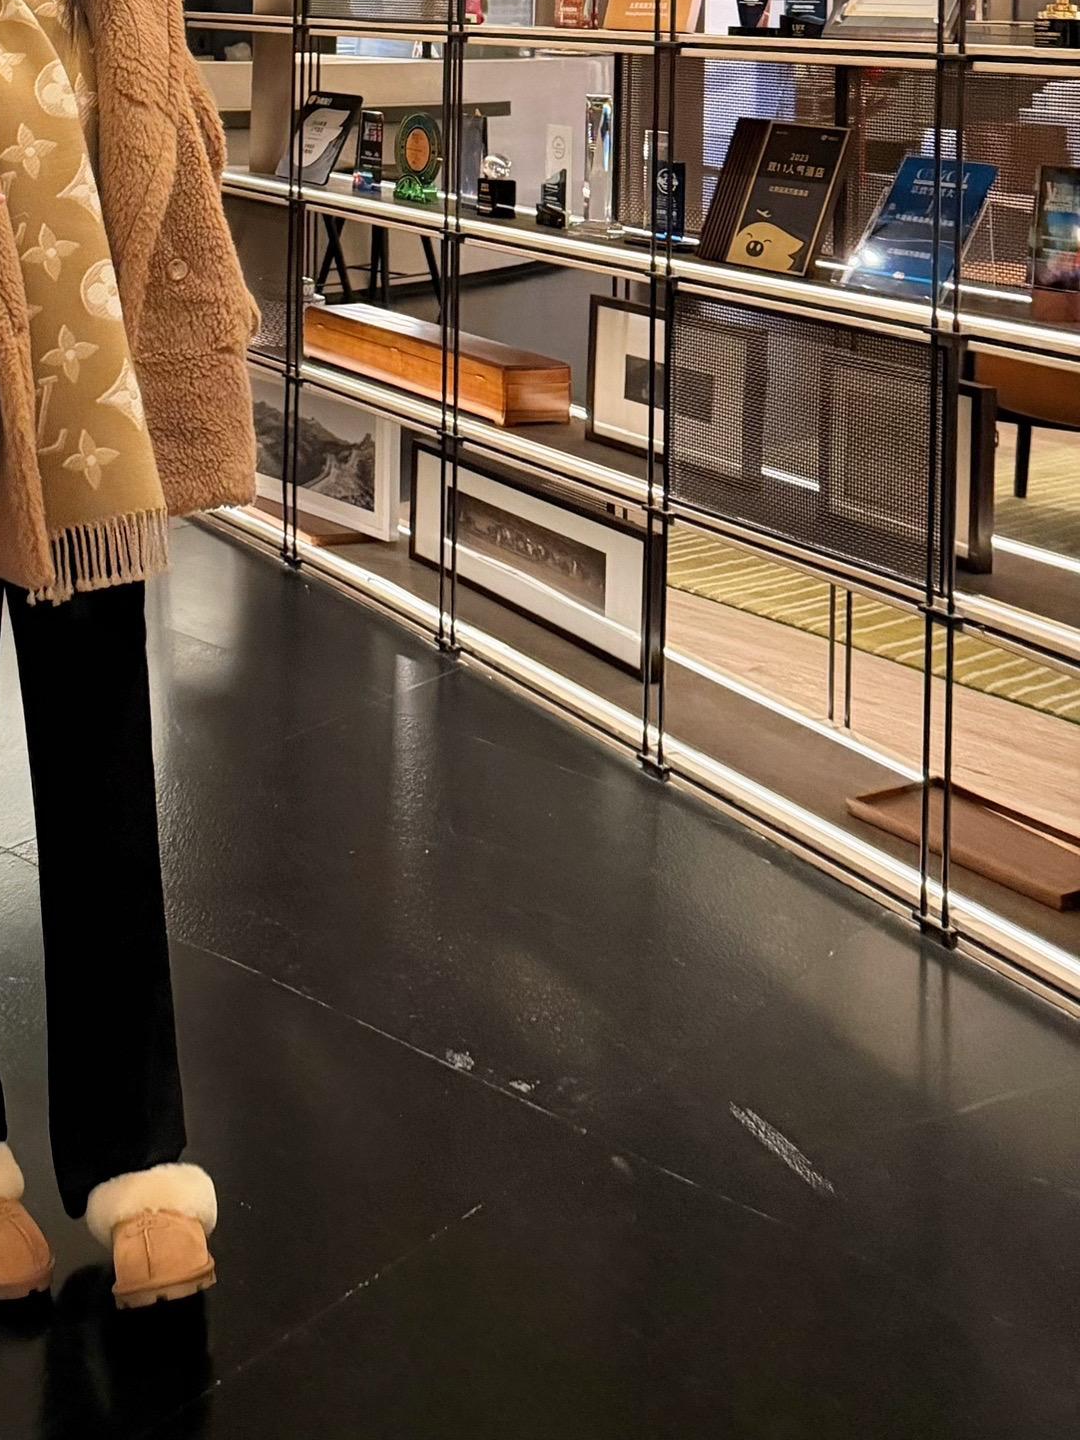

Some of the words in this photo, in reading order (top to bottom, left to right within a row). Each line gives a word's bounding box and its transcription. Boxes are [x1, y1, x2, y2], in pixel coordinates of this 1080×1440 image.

[790, 152, 809, 163] 2023
[767, 161, 825, 178] 双11人气酒店
